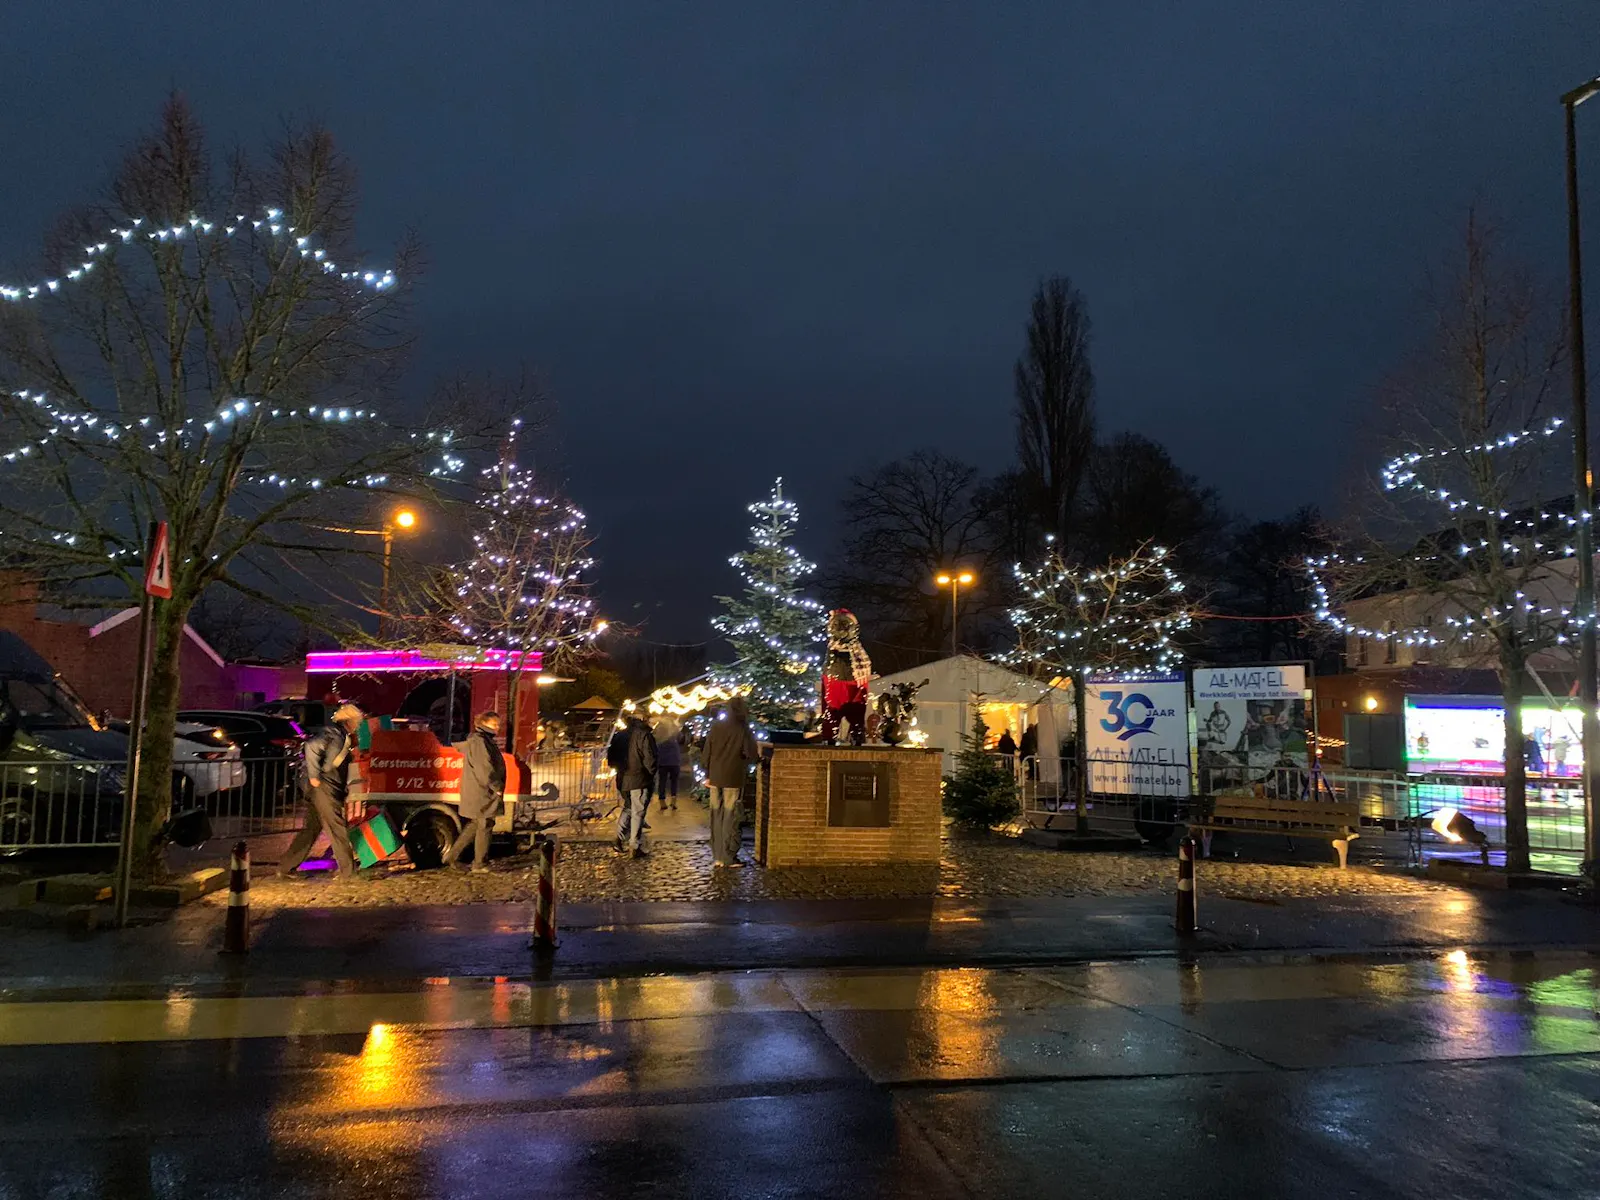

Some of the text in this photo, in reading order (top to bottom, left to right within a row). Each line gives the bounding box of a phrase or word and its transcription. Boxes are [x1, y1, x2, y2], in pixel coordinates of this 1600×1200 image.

[1253, 691, 1267, 699] kop
[1099, 691, 1175, 733] 30 JAAR
[369, 757, 431, 769] Kerstmarkt
[396, 777, 460, 789] 9/12 vanaf
[1094, 774, 1182, 786] www.allmatel.be
